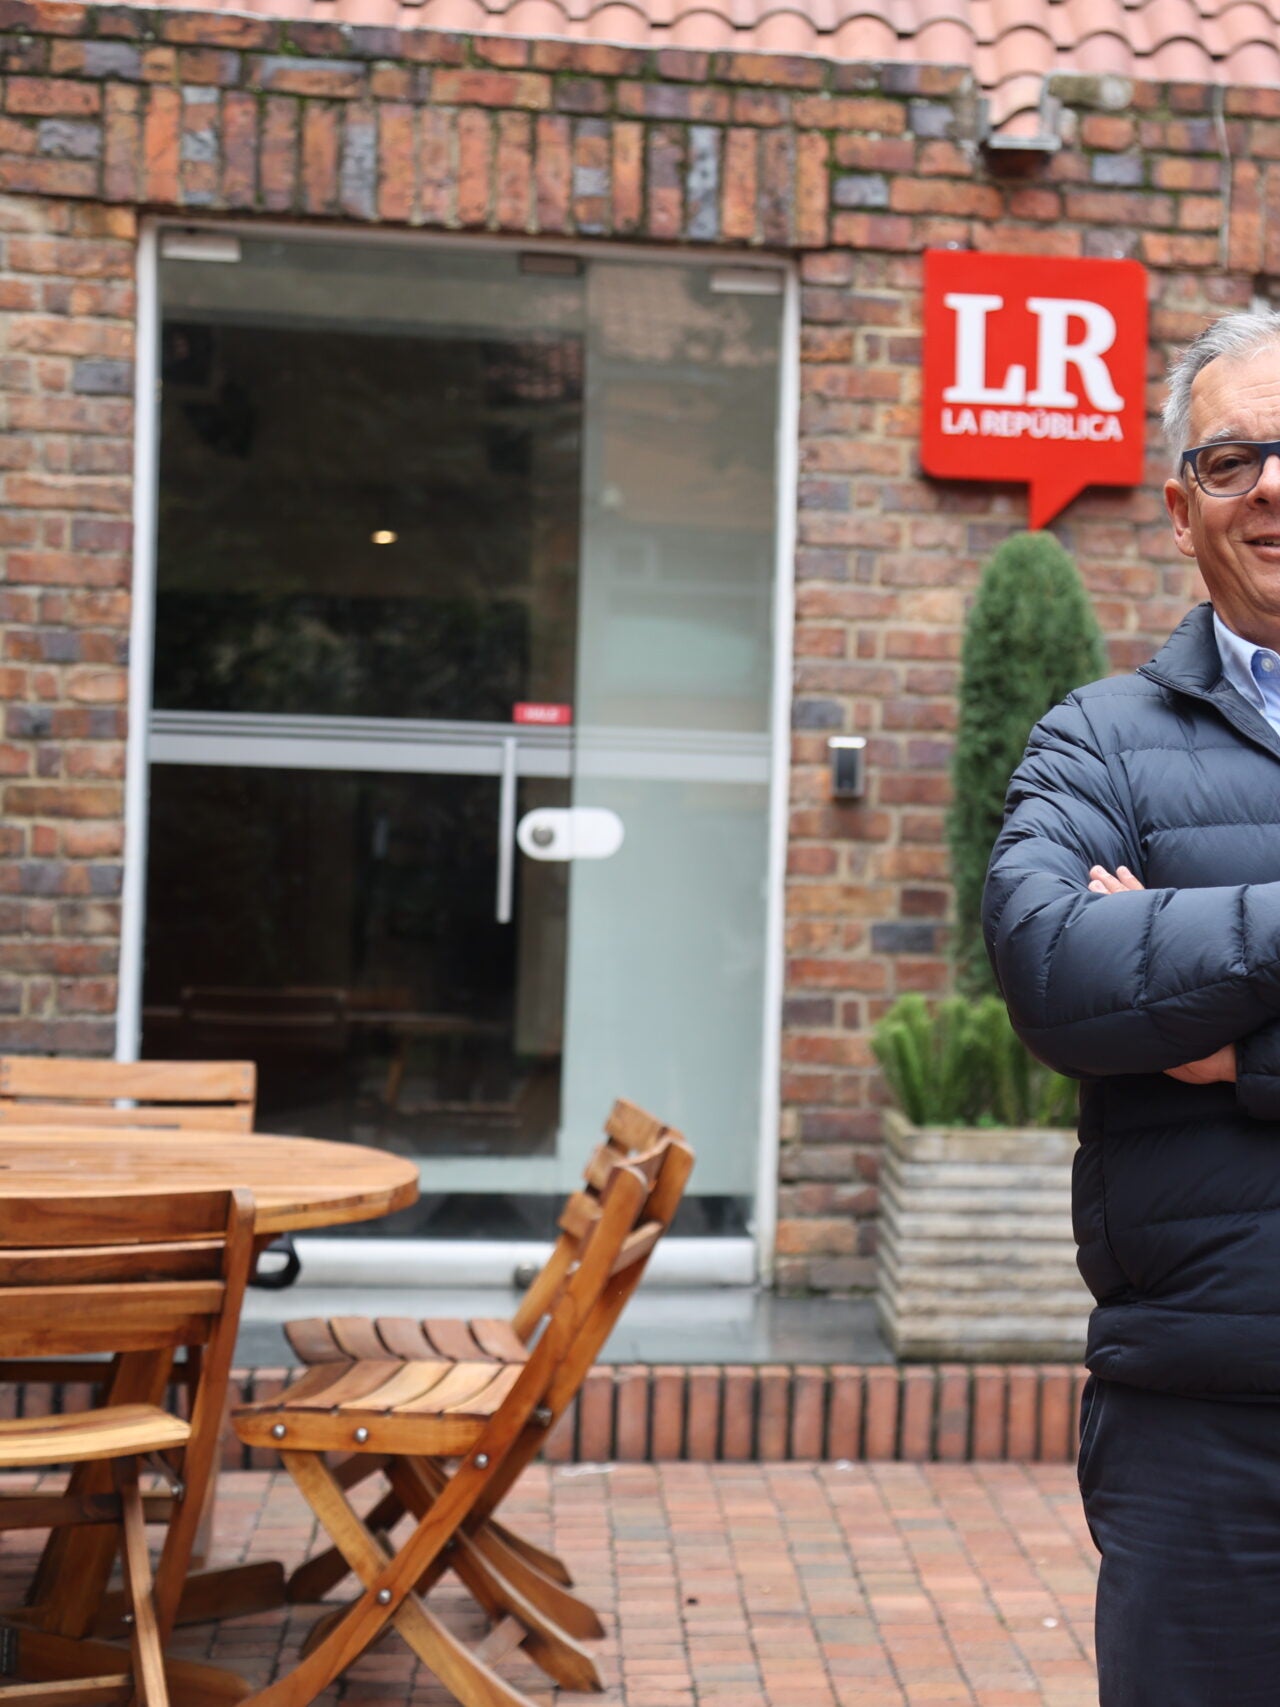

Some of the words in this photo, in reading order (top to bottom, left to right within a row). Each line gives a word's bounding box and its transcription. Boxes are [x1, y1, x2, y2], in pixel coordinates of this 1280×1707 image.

[943, 292, 1125, 412] LR
[941, 408, 978, 435] LA
[979, 409, 1124, 442] REPÚBLICA
